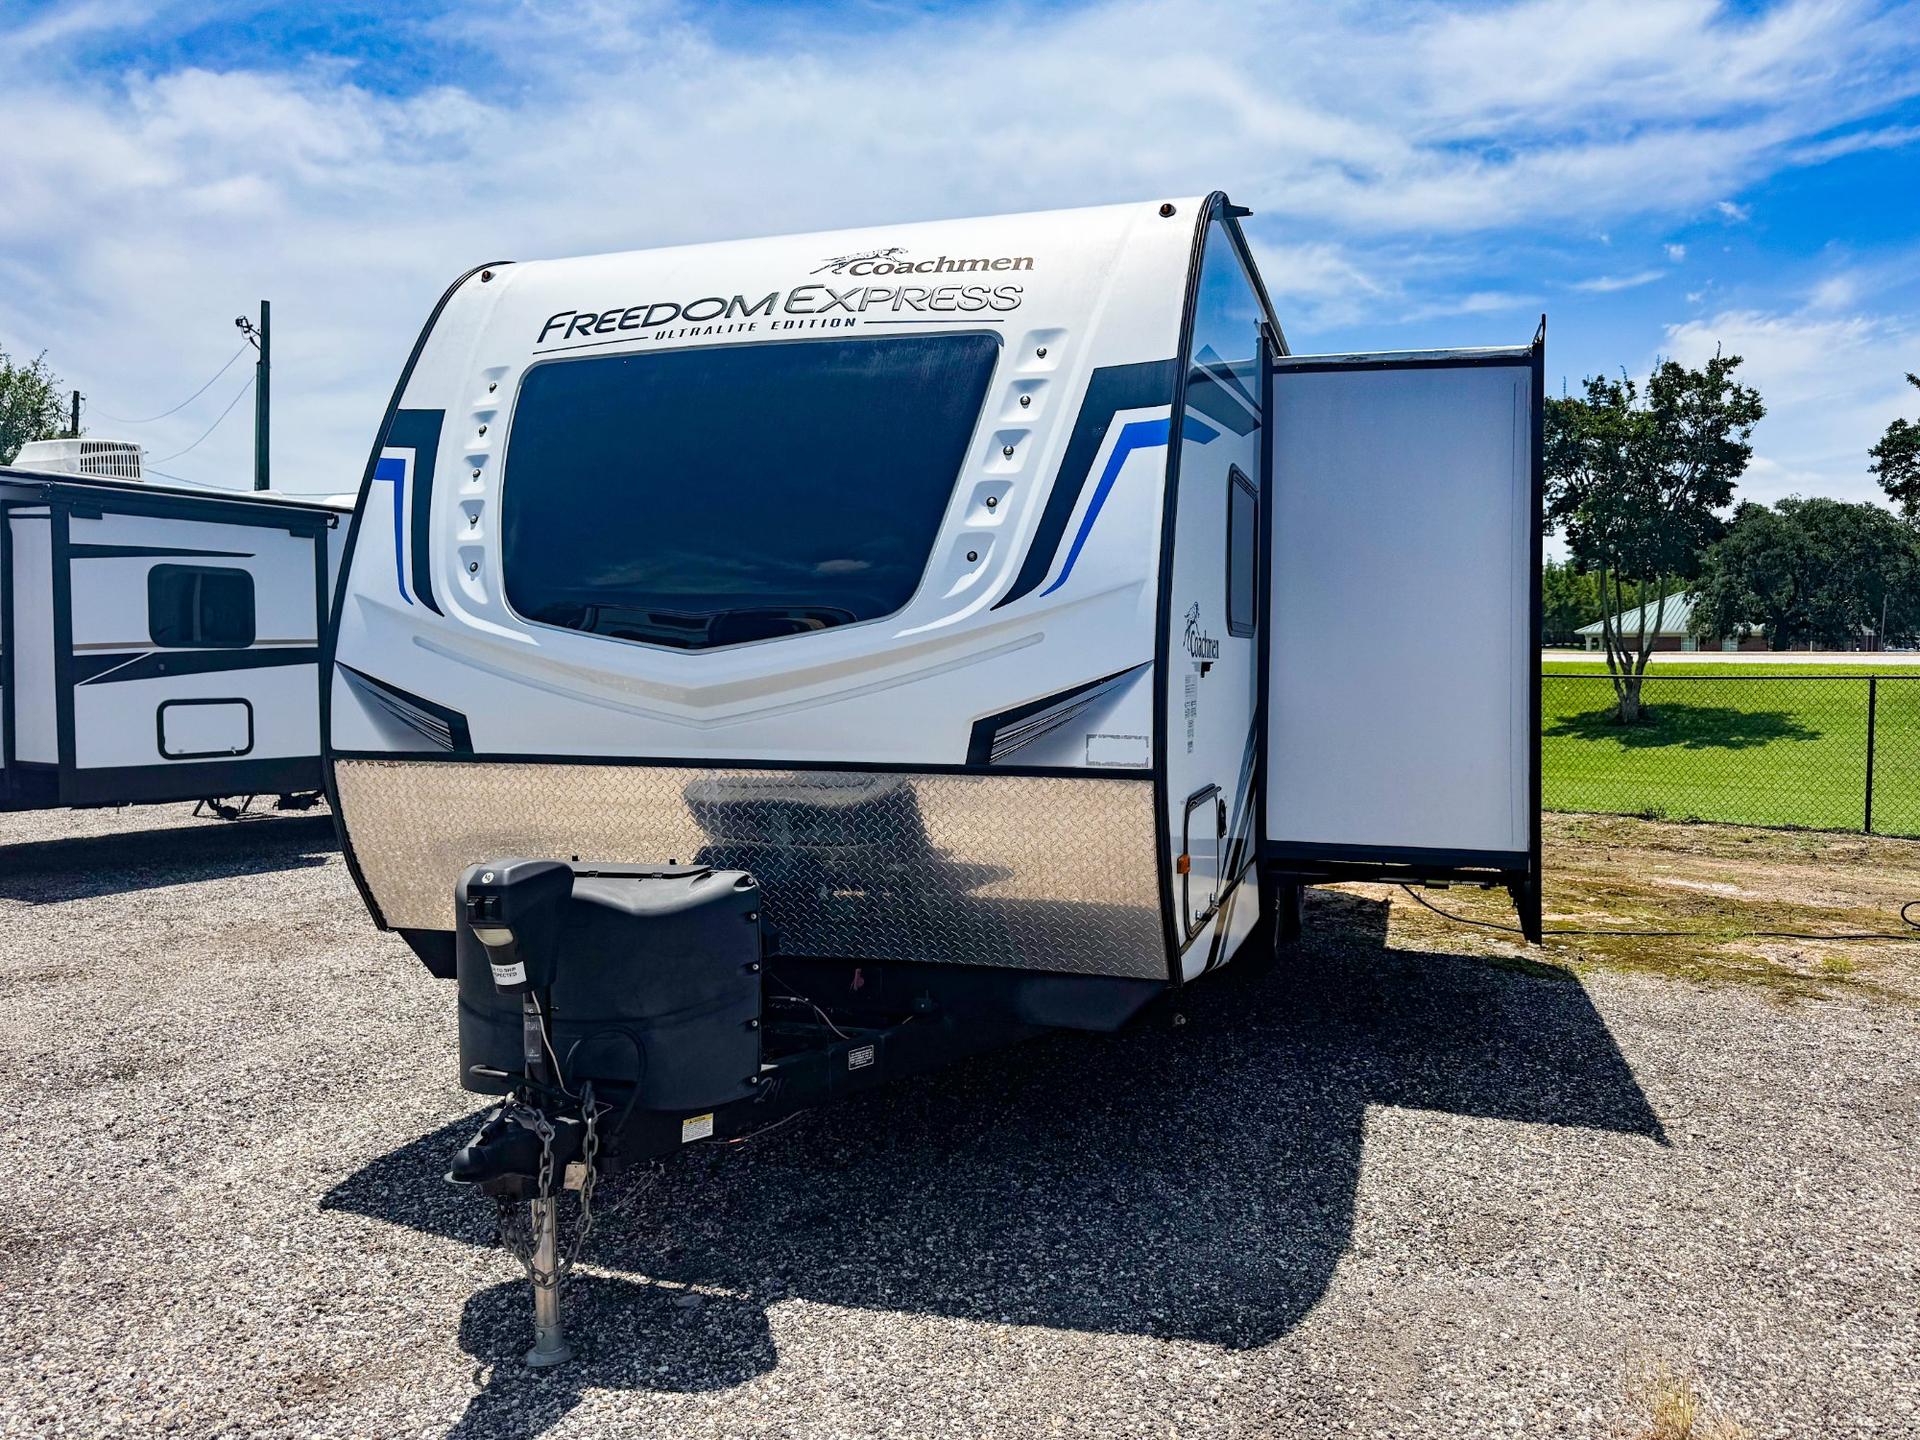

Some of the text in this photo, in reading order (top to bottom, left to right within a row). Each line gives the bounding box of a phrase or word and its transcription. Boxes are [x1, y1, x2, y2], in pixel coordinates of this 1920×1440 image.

[849, 255, 1034, 277] Coachmen
[536, 283, 1025, 344] FREEDOM EXPRESS
[654, 317, 857, 341] ULTRALITE EDITION
[1189, 629, 1220, 660] Coachmen
